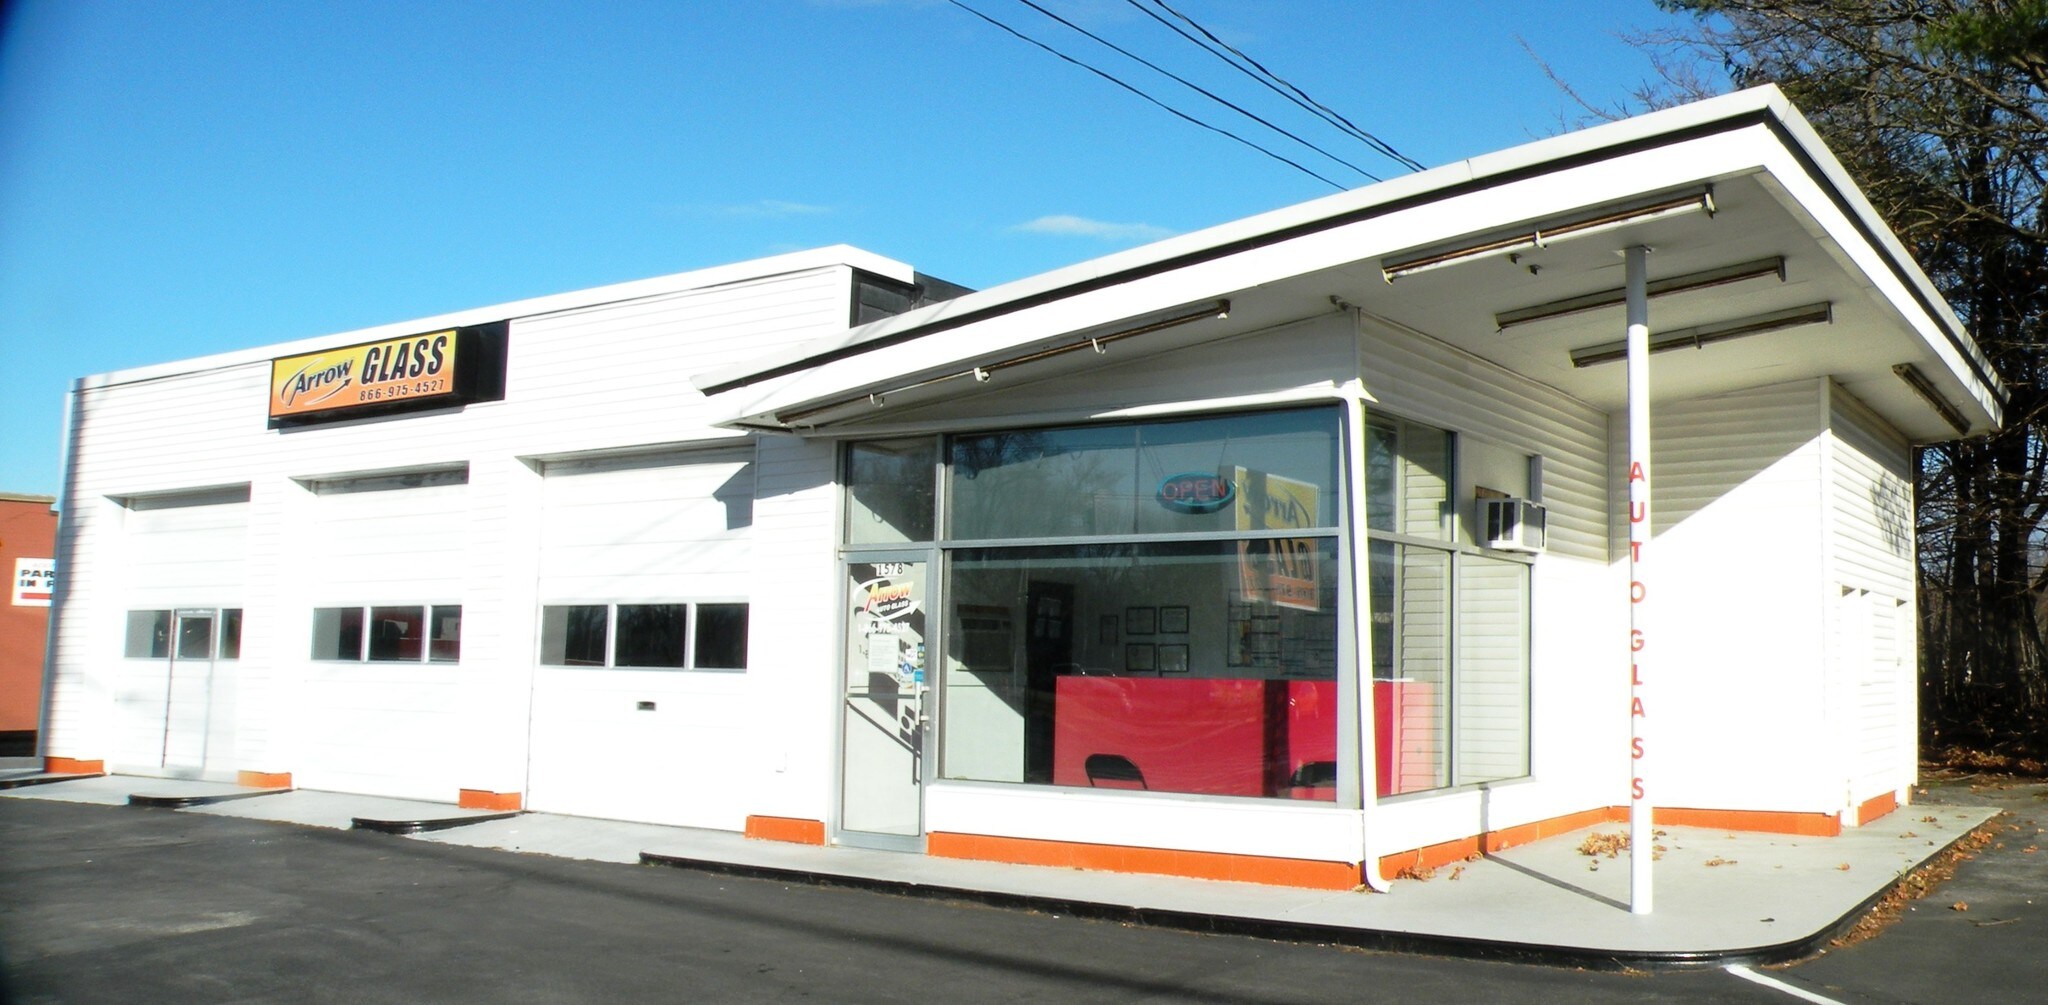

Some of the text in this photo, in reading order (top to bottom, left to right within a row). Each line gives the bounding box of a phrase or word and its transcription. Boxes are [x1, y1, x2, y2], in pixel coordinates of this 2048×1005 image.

[287, 335, 448, 407] Arrow GLASS
[360, 379, 445, 401] 866-975-4527
[1162, 478, 1227, 501] OPEN
[878, 563, 903, 576] 1578
[864, 581, 914, 613] Arrow
[891, 600, 910, 610] GLASS
[1629, 461, 1646, 800] AUTO GLASS
